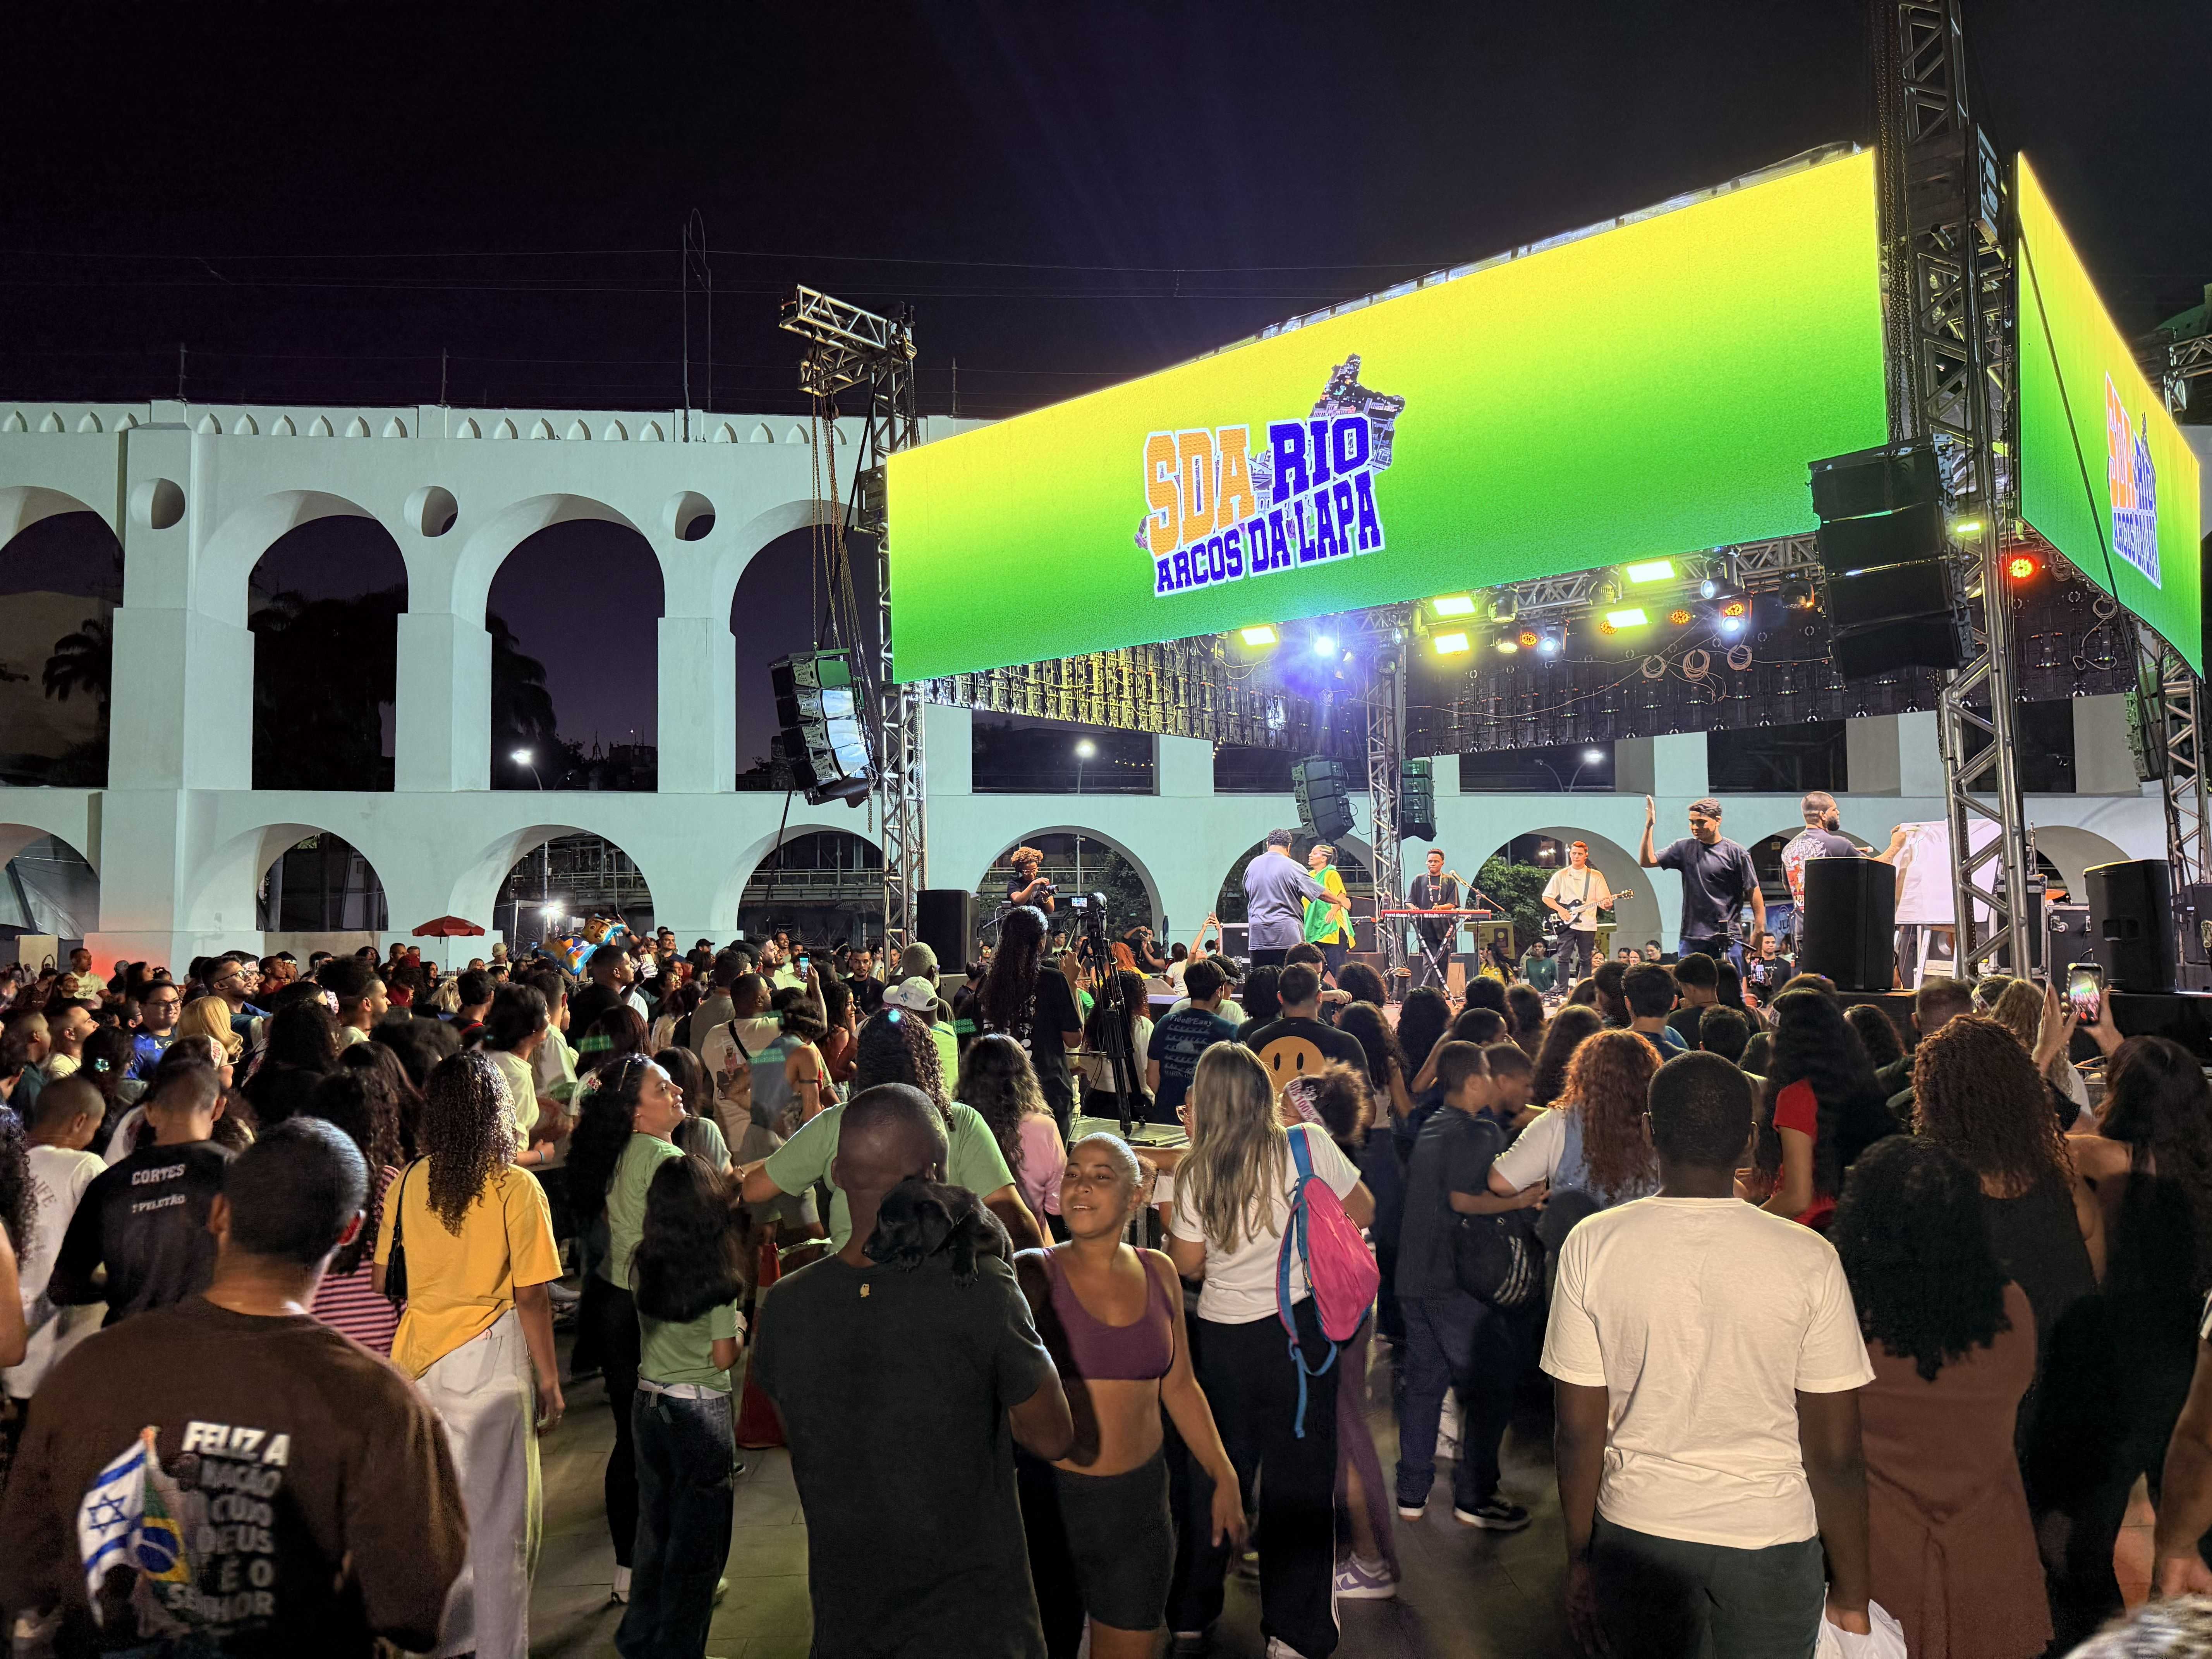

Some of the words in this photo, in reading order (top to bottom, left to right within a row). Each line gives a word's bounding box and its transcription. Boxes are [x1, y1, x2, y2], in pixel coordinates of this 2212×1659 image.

[1146, 426, 1255, 557] SDA
[1269, 415, 1371, 506] RIO
[1156, 528, 1243, 593] ARCOS
[1247, 510, 1292, 574] DA
[1294, 473, 1382, 564] LAPA
[132, 1163, 186, 1185] CORTES
[181, 1421, 267, 1460] FELIZ
[261, 1434, 290, 1467] A
